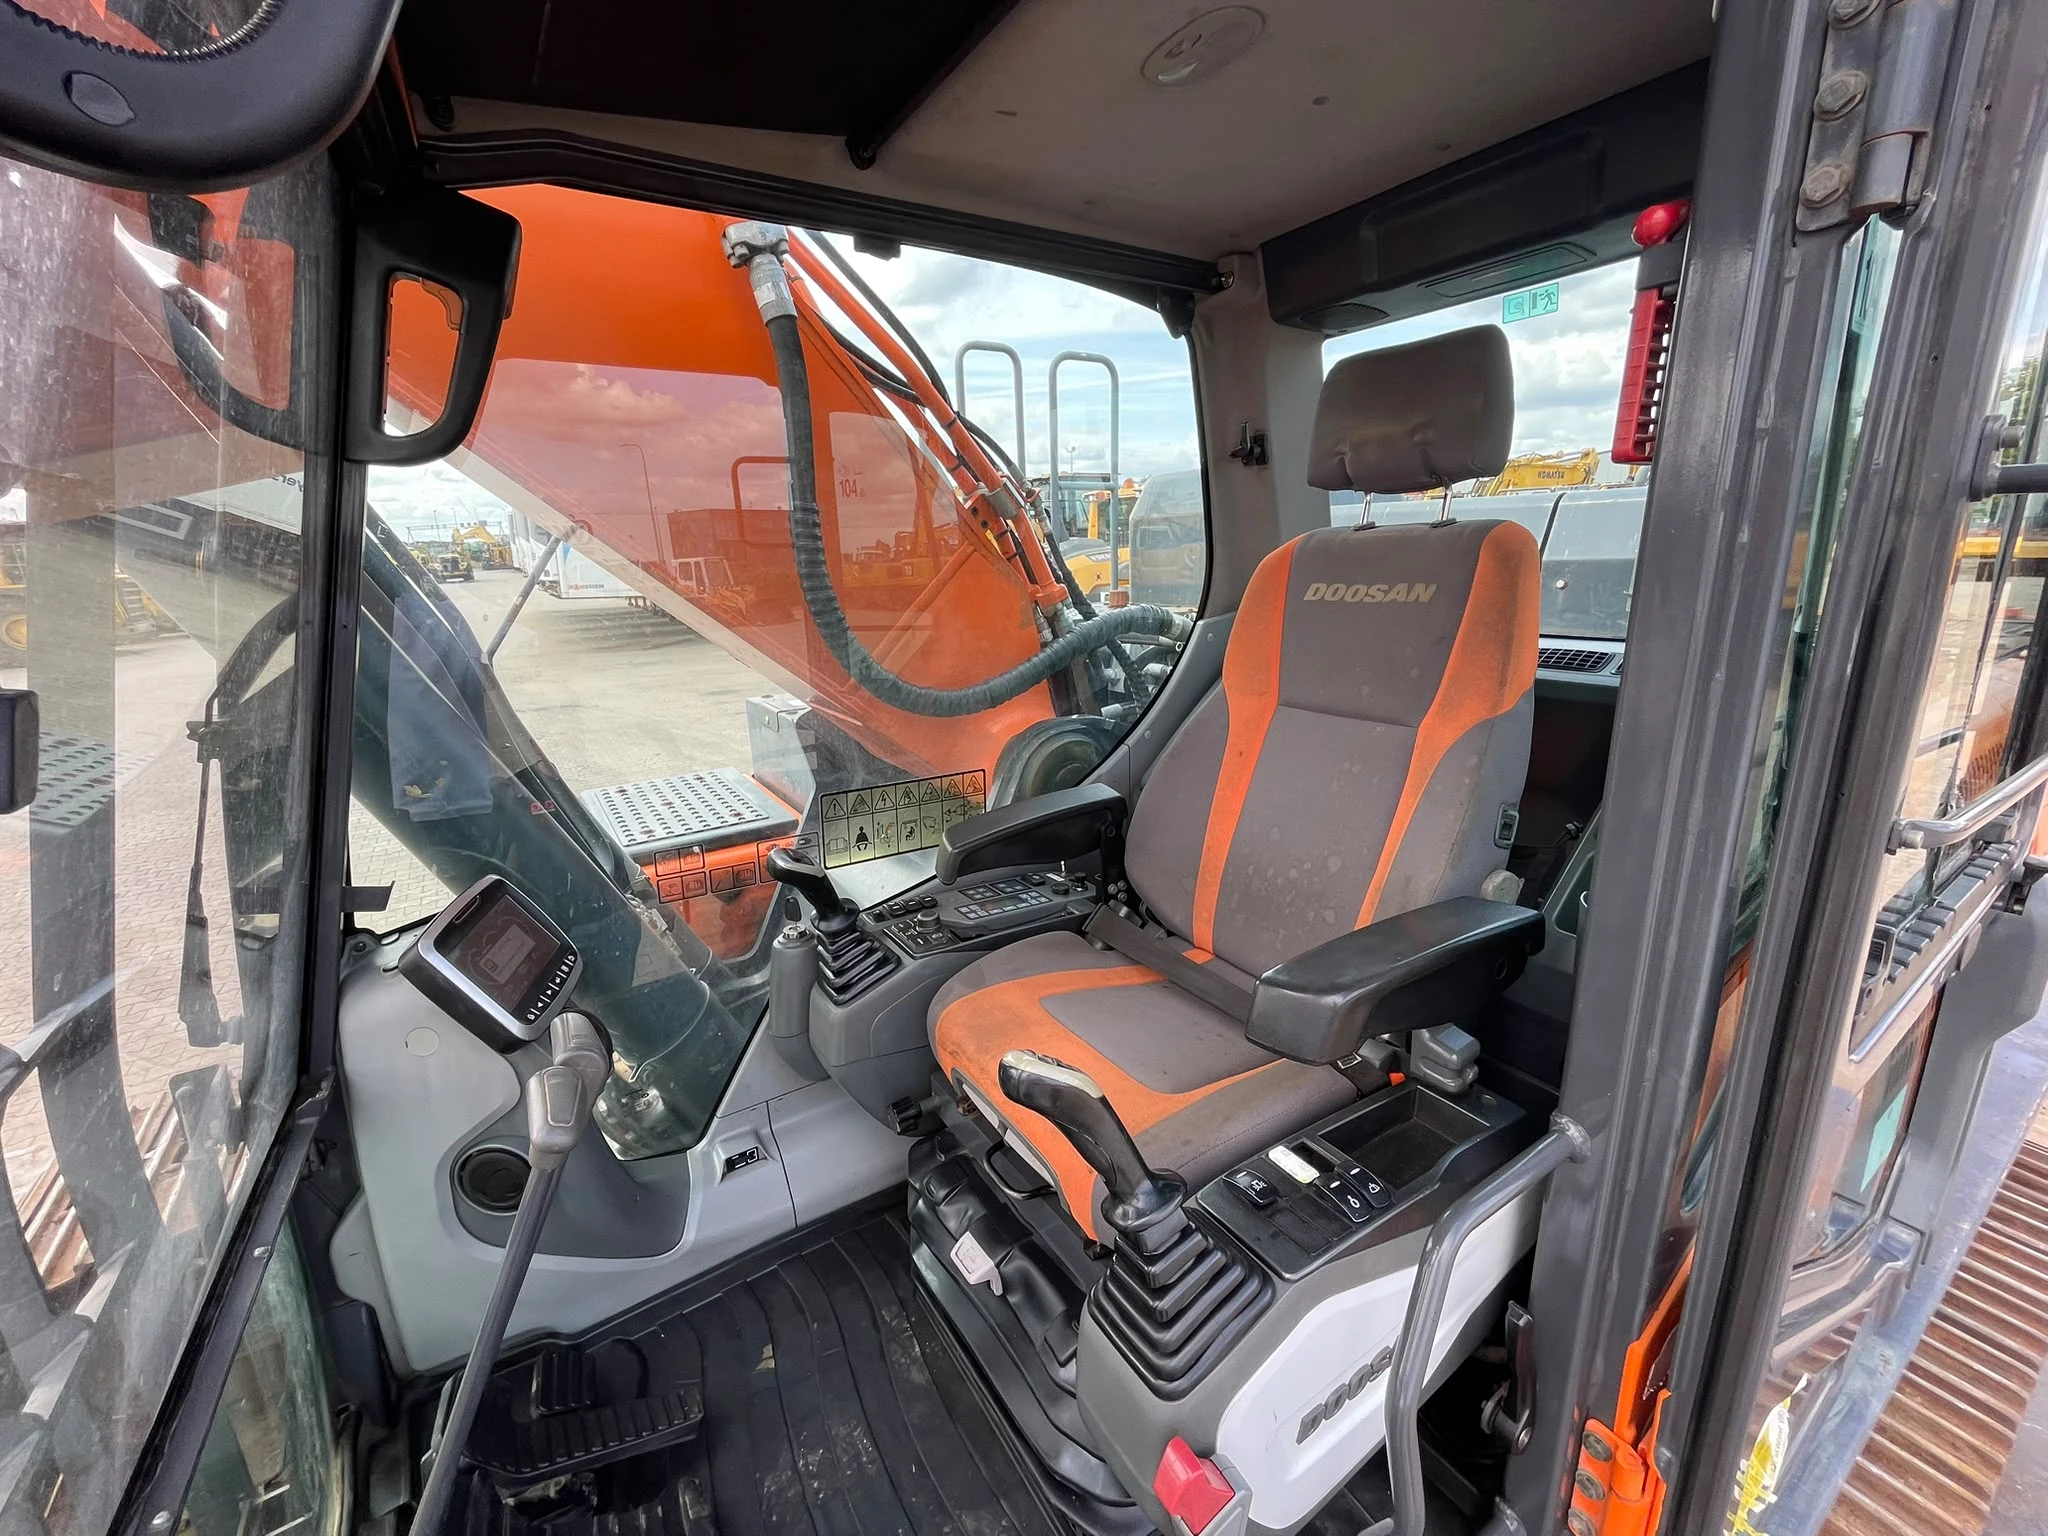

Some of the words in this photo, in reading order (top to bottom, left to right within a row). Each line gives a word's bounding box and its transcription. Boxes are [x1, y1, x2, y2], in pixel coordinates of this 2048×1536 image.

[1537, 470, 1565, 479] KOMATSU
[840, 479, 858, 497] 104
[1303, 582, 1437, 603] DOOSAN
[1295, 1334, 1399, 1446] DOOS
